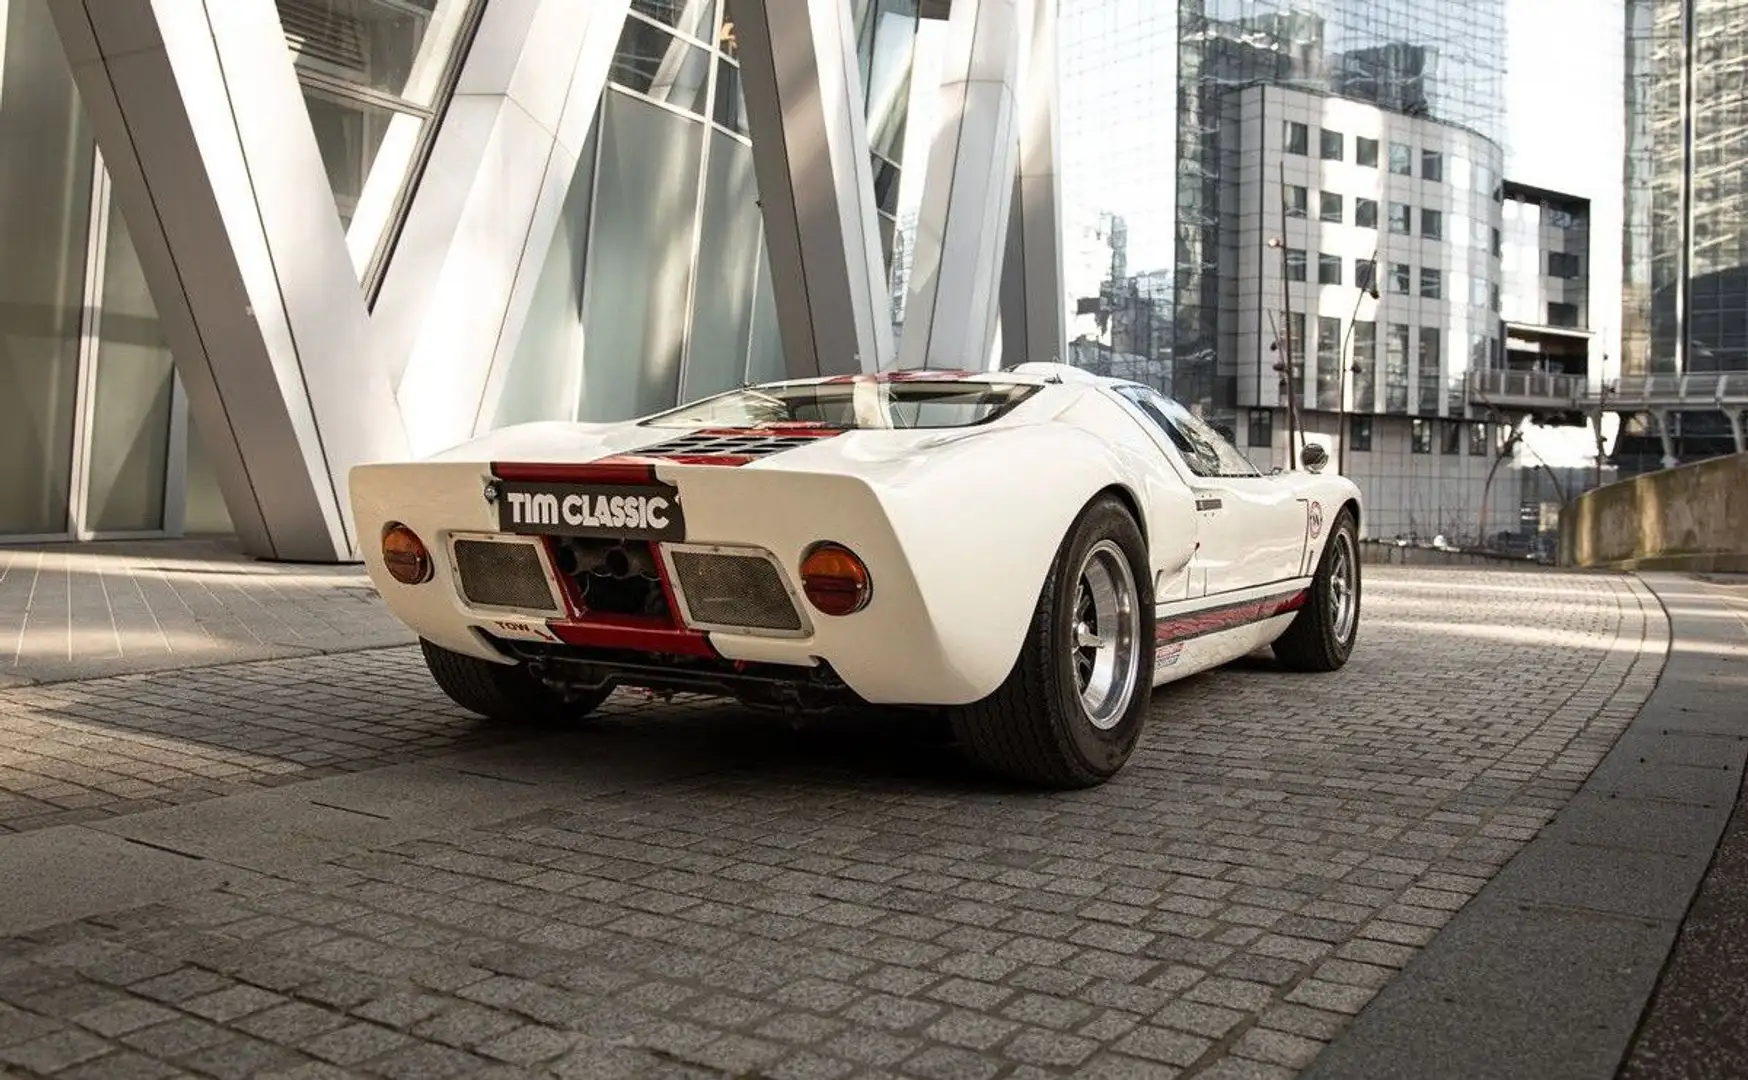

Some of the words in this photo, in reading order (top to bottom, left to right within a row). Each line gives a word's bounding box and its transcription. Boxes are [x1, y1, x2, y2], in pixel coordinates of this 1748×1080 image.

[507, 492, 559, 525] TIM
[562, 494, 670, 529] CLASSIC
[494, 620, 530, 632] TOW
